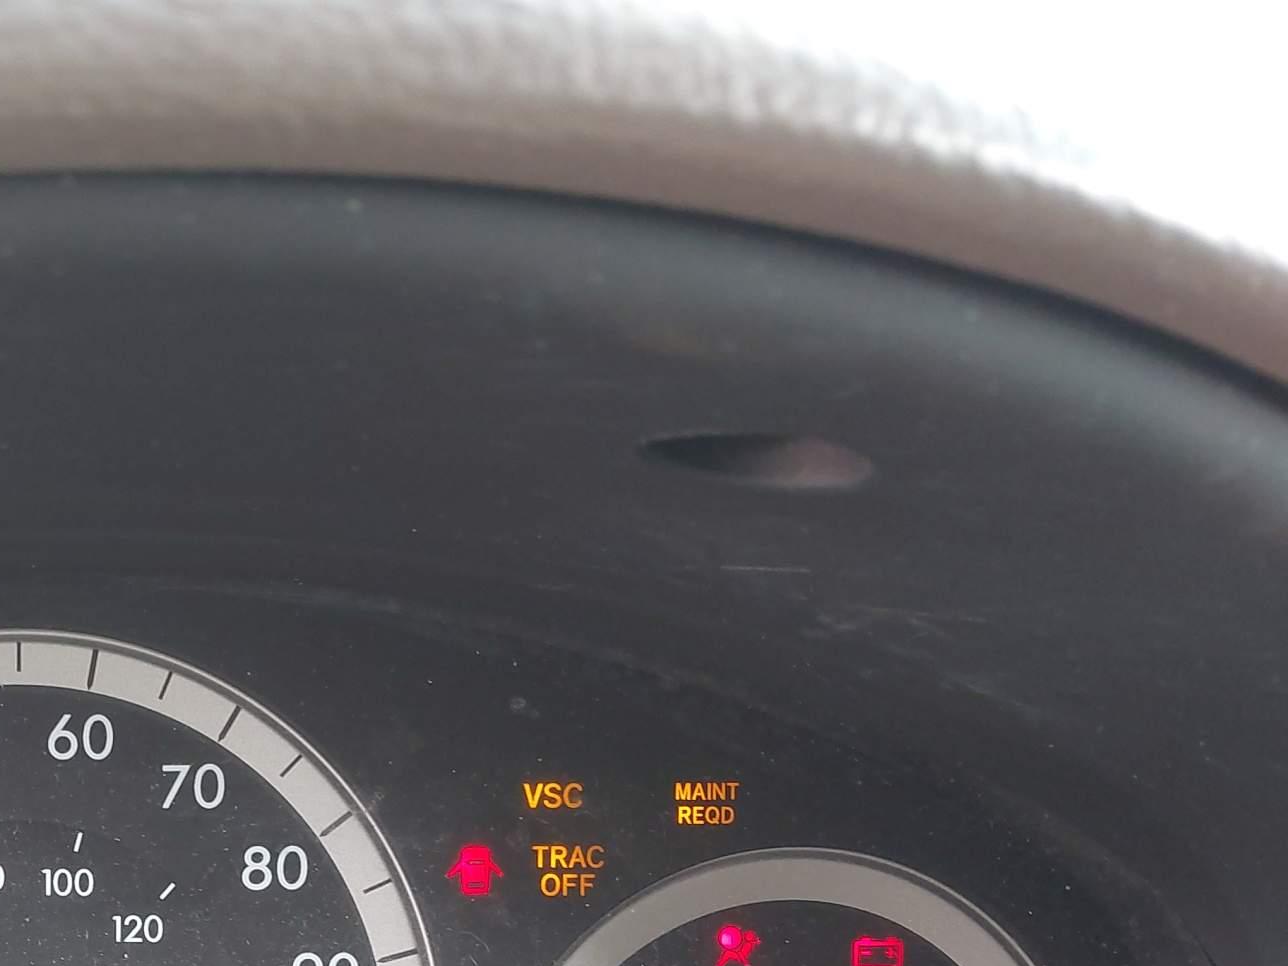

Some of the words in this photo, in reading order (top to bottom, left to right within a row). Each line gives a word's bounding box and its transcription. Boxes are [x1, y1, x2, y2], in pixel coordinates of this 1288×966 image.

[47, 713, 113, 762] 60
[161, 764, 226, 810] 70
[523, 783, 584, 809] VSC
[674, 783, 739, 801] MAINT
[677, 806, 735, 826] REQD
[241, 845, 308, 891] 80
[532, 844, 605, 870] TRAC
[41, 869, 95, 898] 100
[540, 873, 594, 898] OFF
[113, 915, 164, 945] 120
